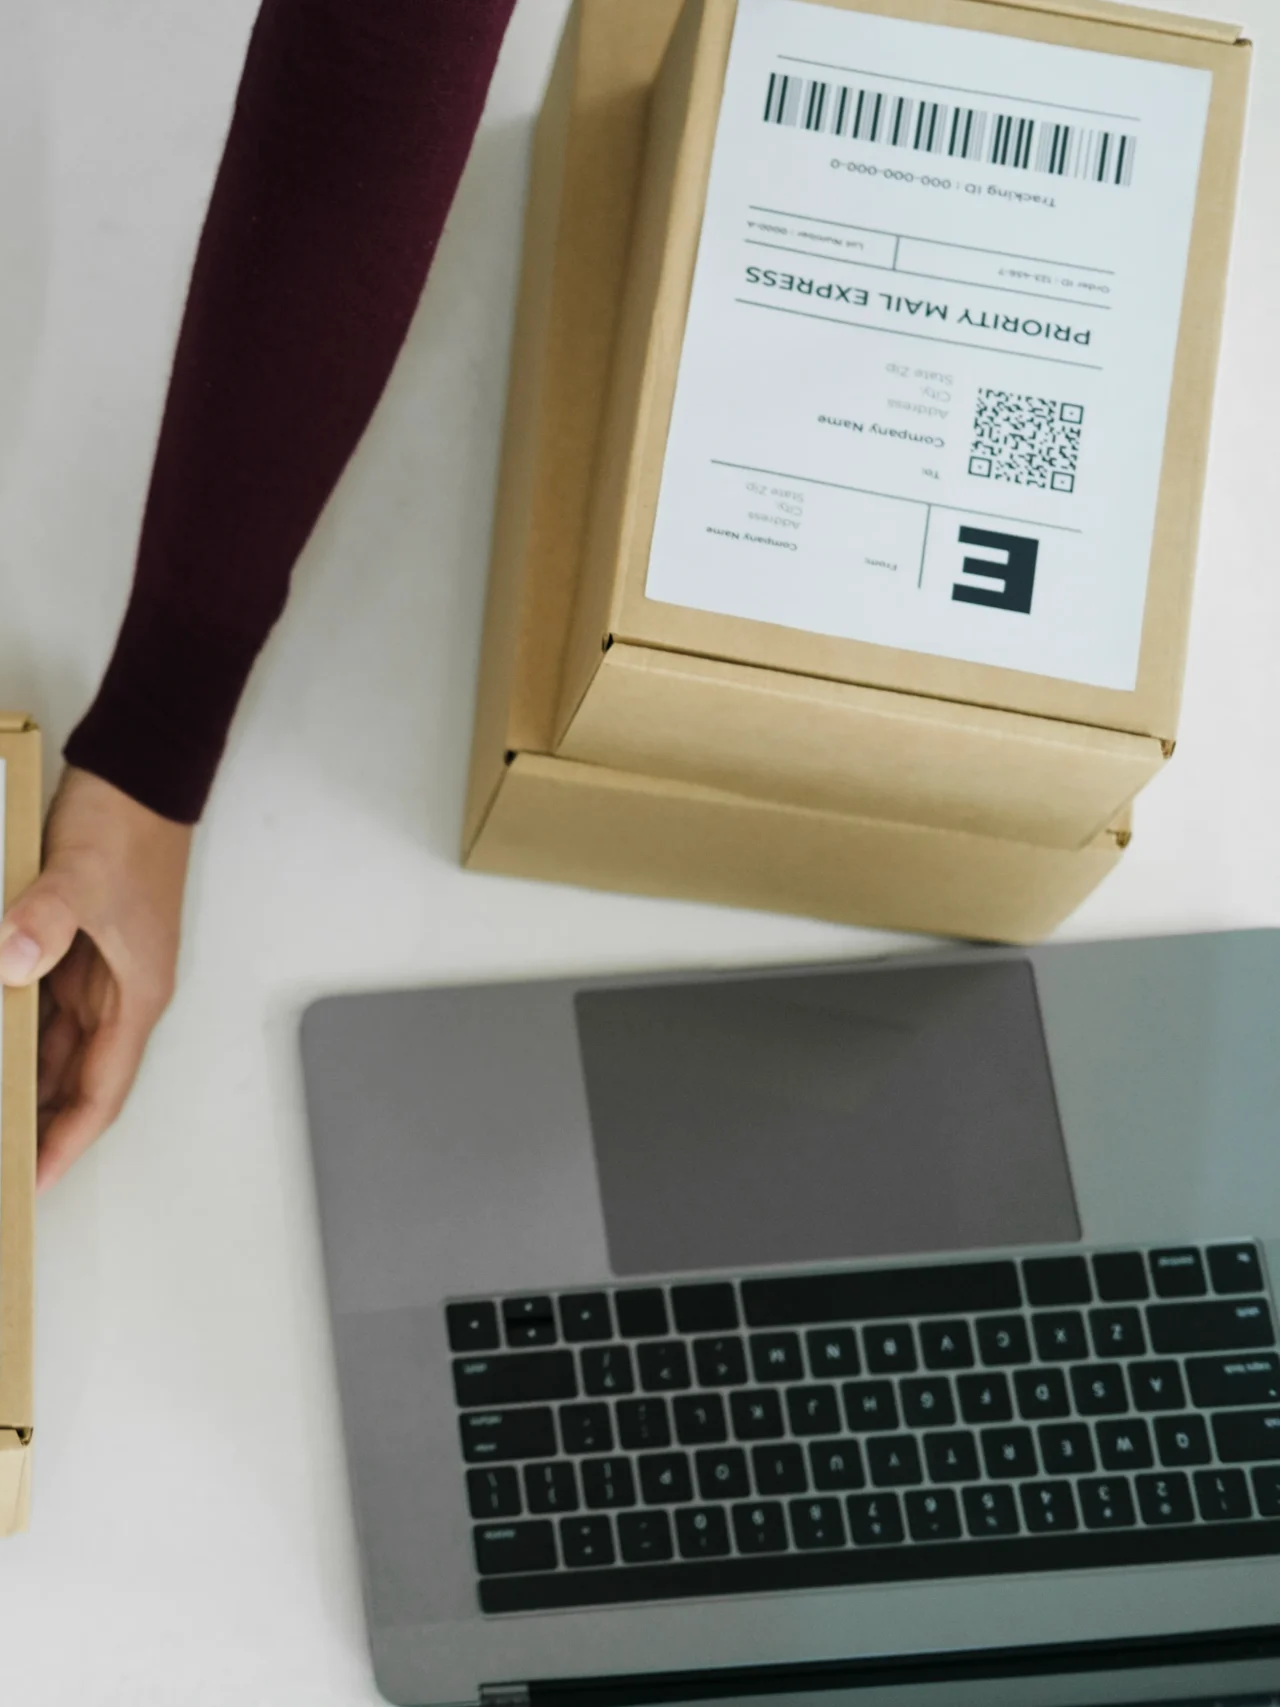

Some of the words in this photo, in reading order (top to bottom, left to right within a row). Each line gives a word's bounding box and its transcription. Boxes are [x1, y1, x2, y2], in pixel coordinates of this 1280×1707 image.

[830, 158, 951, 189] 000-000-000-0
[964, 184, 982, 194] ID
[987, 185, 1055, 207] Tracking
[746, 267, 868, 306] EXPRESS
[880, 294, 947, 320] MAIL
[958, 309, 1090, 345] PRIORITY
[888, 399, 948, 419] Address
[818, 416, 863, 432] Name
[870, 424, 945, 447] Company
[748, 512, 800, 529] Address
[706, 527, 739, 540] Name
[743, 533, 797, 550] Company
[952, 526, 1039, 614] E
[1055, 1329, 1066, 1343] X
[1111, 1323, 1122, 1341] Z
[941, 1335, 953, 1351] V
[825, 1344, 841, 1359] N
[1035, 1383, 1049, 1401] D
[1091, 1381, 1105, 1398] S
[1149, 1378, 1162, 1392] A
[863, 1397, 877, 1411] H
[981, 1389, 991, 1405] F
[751, 1405, 763, 1419] K
[1061, 1439, 1073, 1457] E
[1116, 1437, 1133, 1451] W
[1175, 1432, 1189, 1449] Q
[889, 1453, 900, 1467] Y
[947, 1449, 957, 1465] T
[1003, 1445, 1016, 1461] R
[829, 1455, 844, 1471] U
